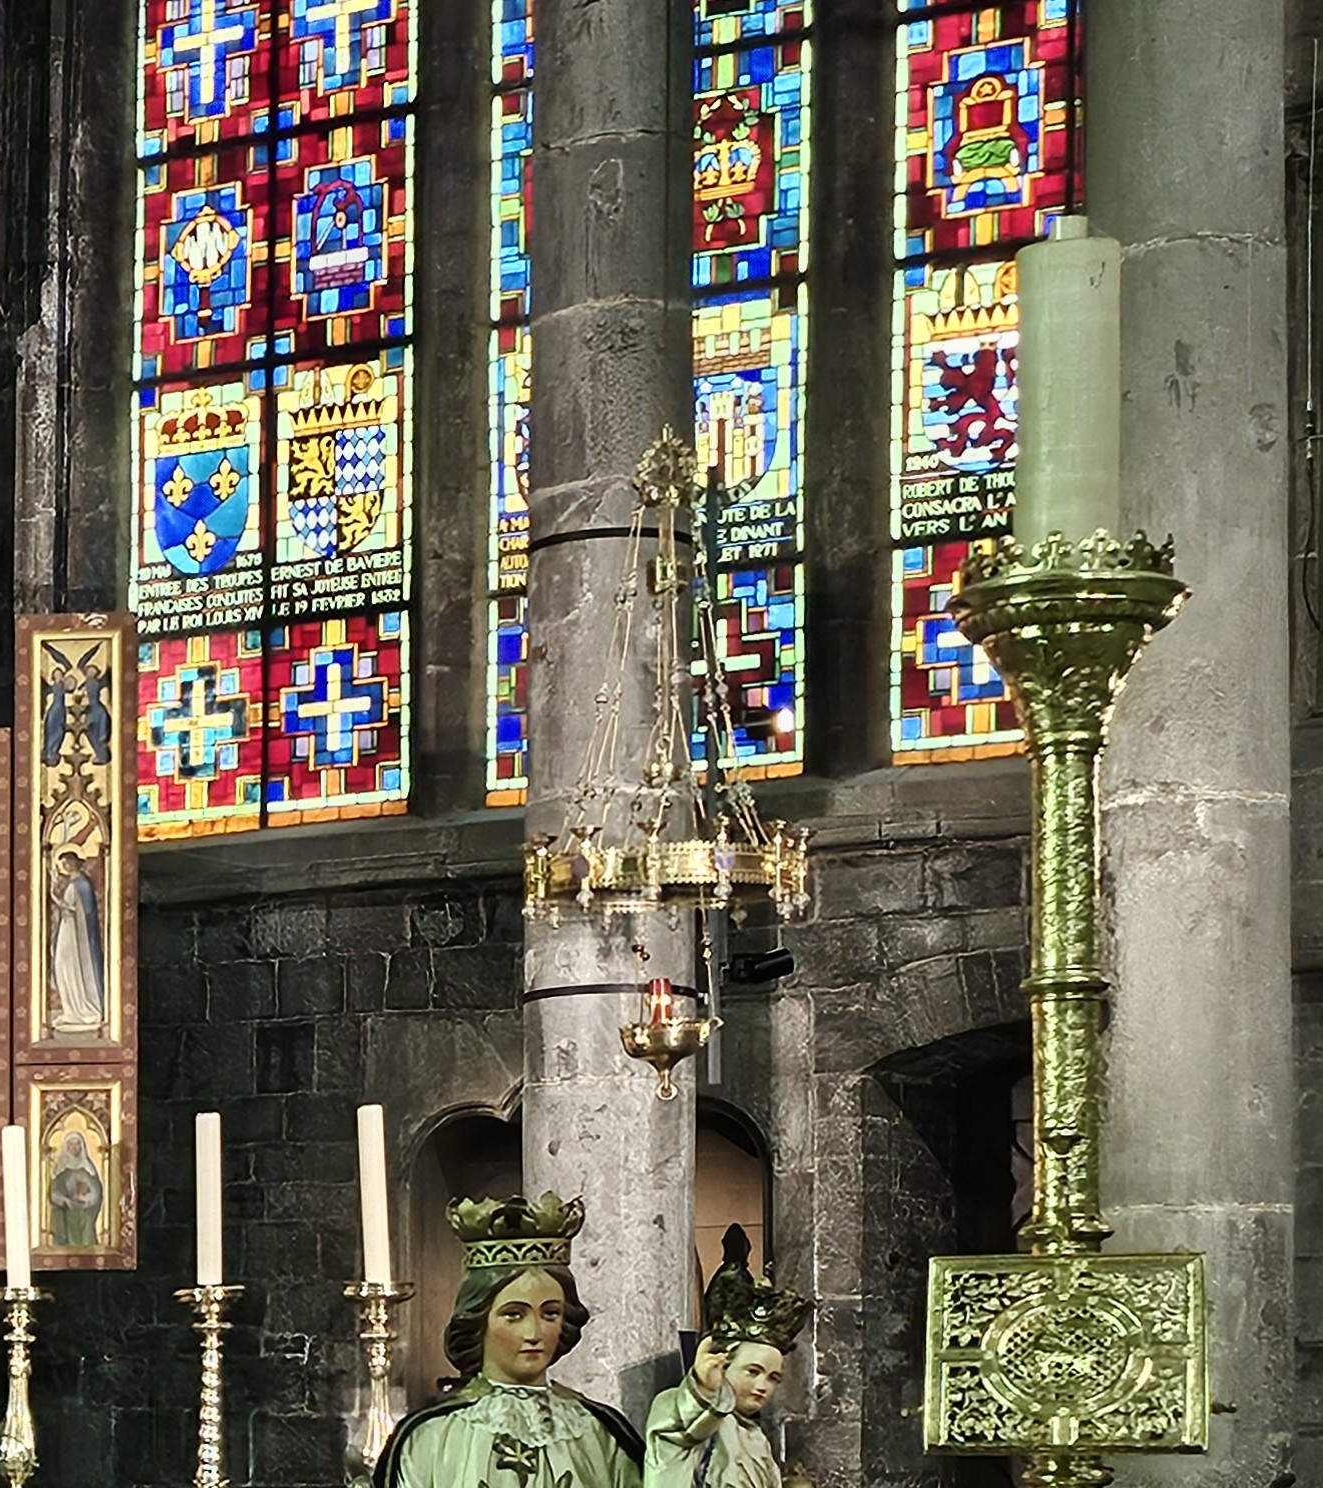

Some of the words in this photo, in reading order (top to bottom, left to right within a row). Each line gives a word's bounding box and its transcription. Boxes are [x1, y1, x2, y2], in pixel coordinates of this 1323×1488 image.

[902, 478, 953, 499] ROBERT
[959, 476, 979, 493] DE
[750, 504, 771, 520] DE
[775, 501, 796, 517] LA
[901, 496, 982, 519] CONSACRA
[730, 521, 785, 542] DINANT
[902, 518, 950, 537] VERS
[213, 569, 264, 590] TROUPES
[270, 561, 322, 582] ERNEST
[324, 558, 344, 575] DE
[270, 583, 289, 599] FIT
[292, 581, 308, 598] SA
[294, 600, 308, 615] 19
[137, 619, 161, 635] PAR
[206, 609, 242, 627] LOUIS
[243, 605, 264, 622] XIV
